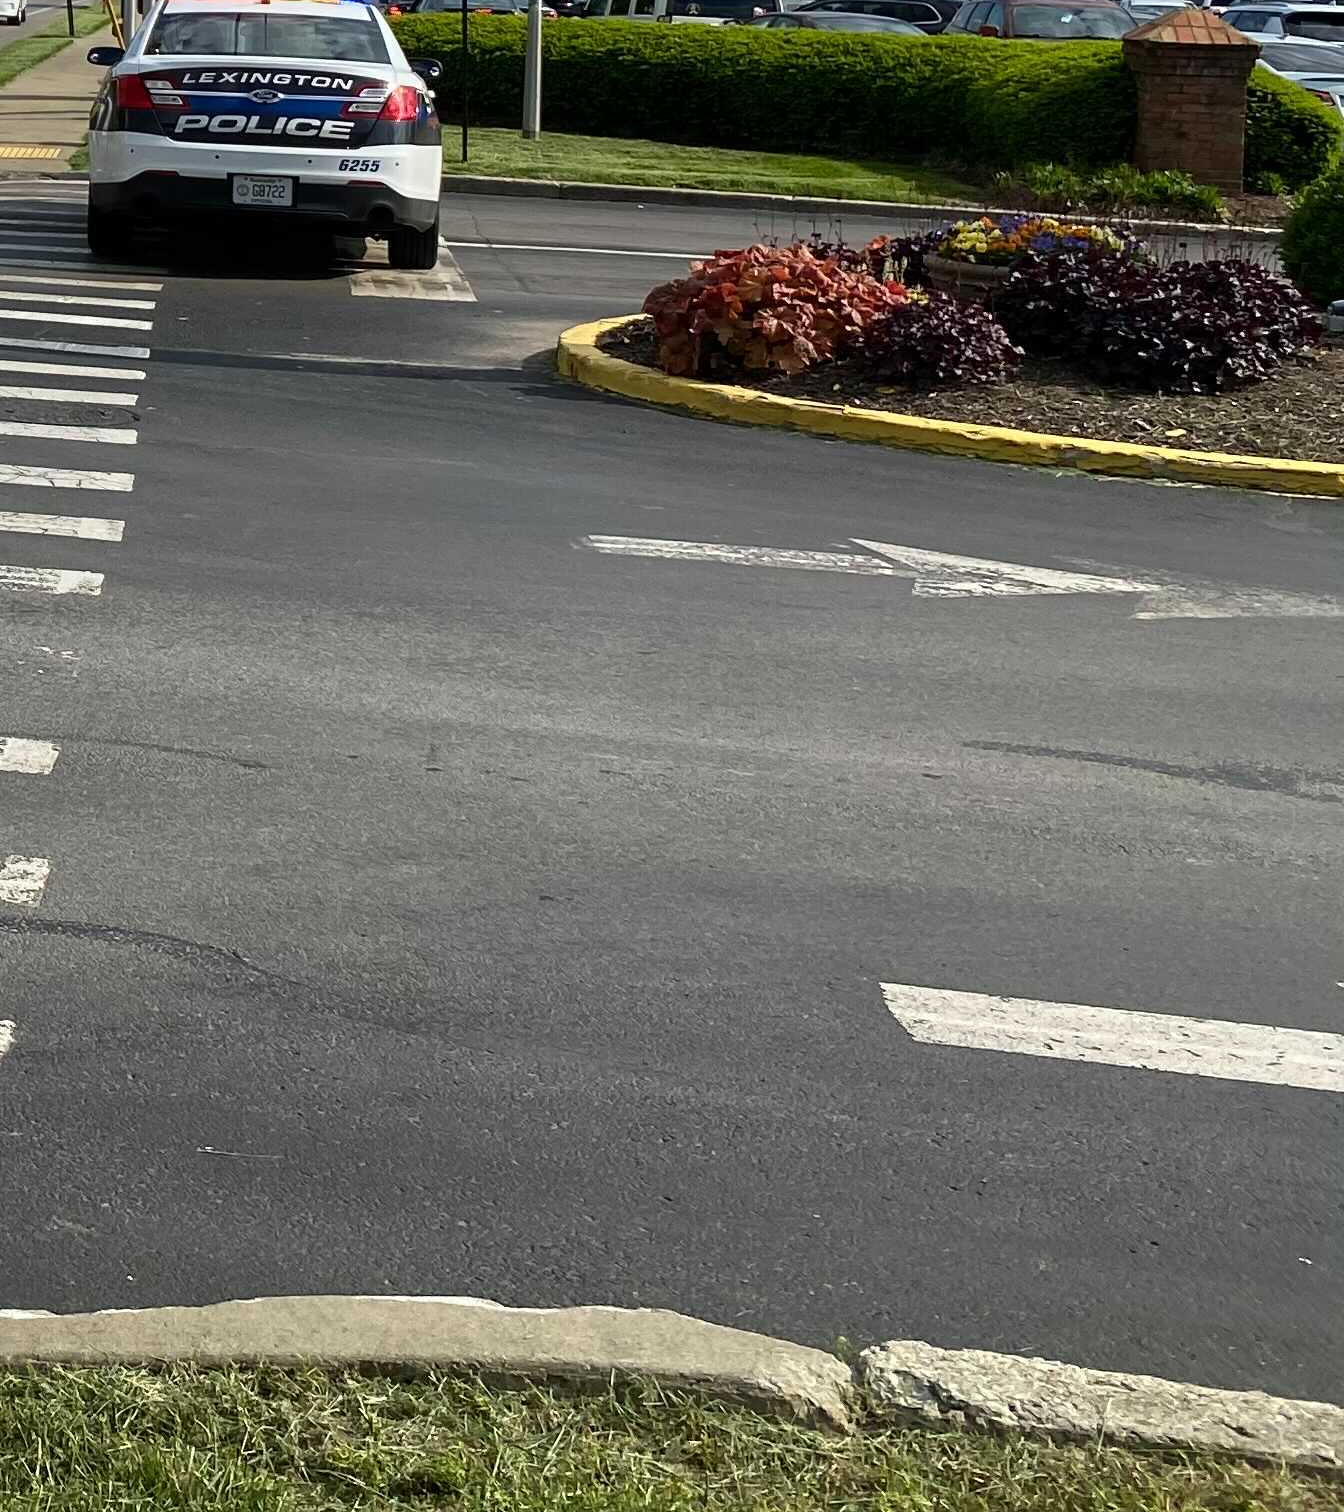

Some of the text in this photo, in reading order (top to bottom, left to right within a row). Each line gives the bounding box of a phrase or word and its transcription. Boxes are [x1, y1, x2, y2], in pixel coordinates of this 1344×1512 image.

[182, 72, 354, 89] LEXINGTON
[174, 114, 356, 140] POLICE
[338, 159, 381, 173] 6255
